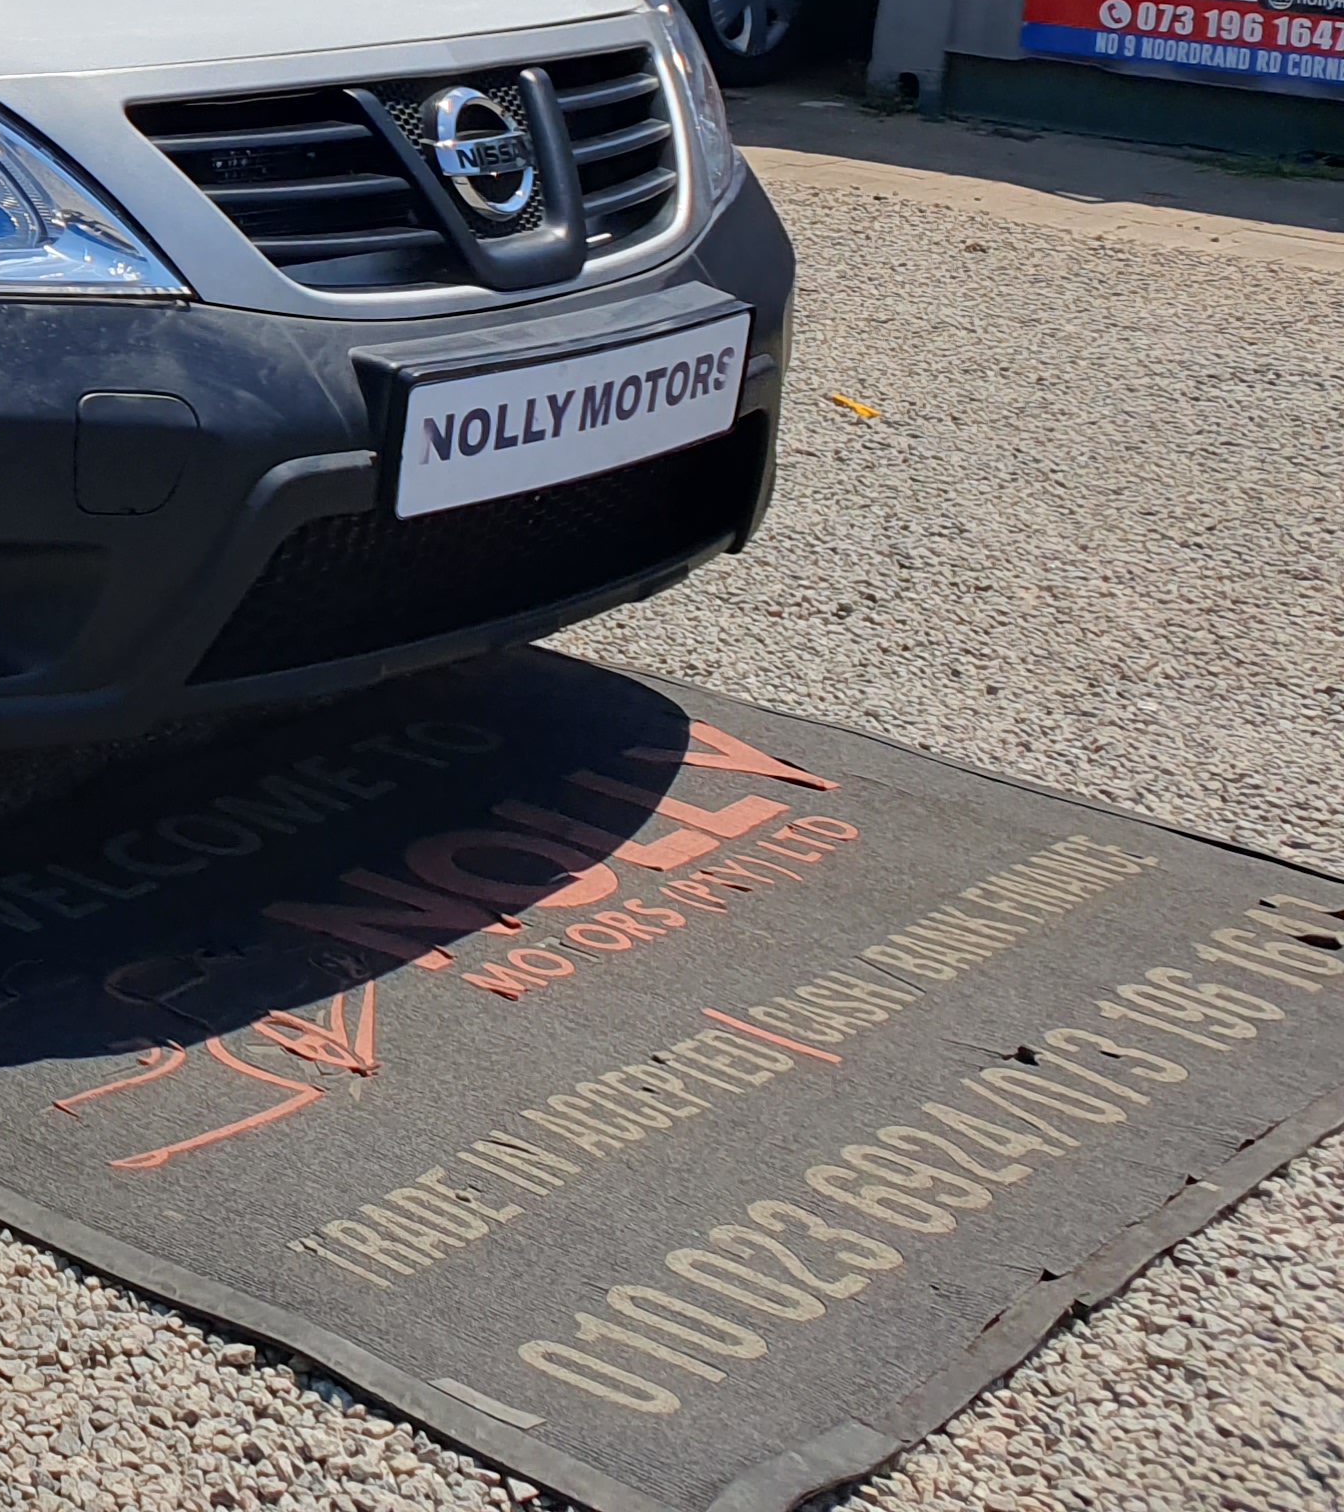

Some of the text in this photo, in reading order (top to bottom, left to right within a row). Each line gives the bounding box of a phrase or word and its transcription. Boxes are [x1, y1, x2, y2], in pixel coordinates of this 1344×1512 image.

[1095, 31, 1119, 55] NO
[1124, 35, 1136, 57] 9
[1141, 37, 1250, 70] NOORDRAND
[1255, 50, 1282, 73] RD
[1137, 1, 1344, 52] 073 196 1647
[419, 346, 736, 465] NOLLY MOTORS
[353, 720, 503, 769] TO
[262, 720, 841, 971] NOLLY
[461, 815, 860, 1001] MOTORS (PTY) LTD
[286, 1164, 526, 1290] TRADE
[456, 1129, 582, 1197] IN
[519, 1028, 795, 1158] ACCEPTED
[958, 834, 1159, 925] FINANCE
[518, 1285, 769, 1415] 010
[665, 1198, 904, 1322] 023
[1093, 966, 1286, 1052] 196
